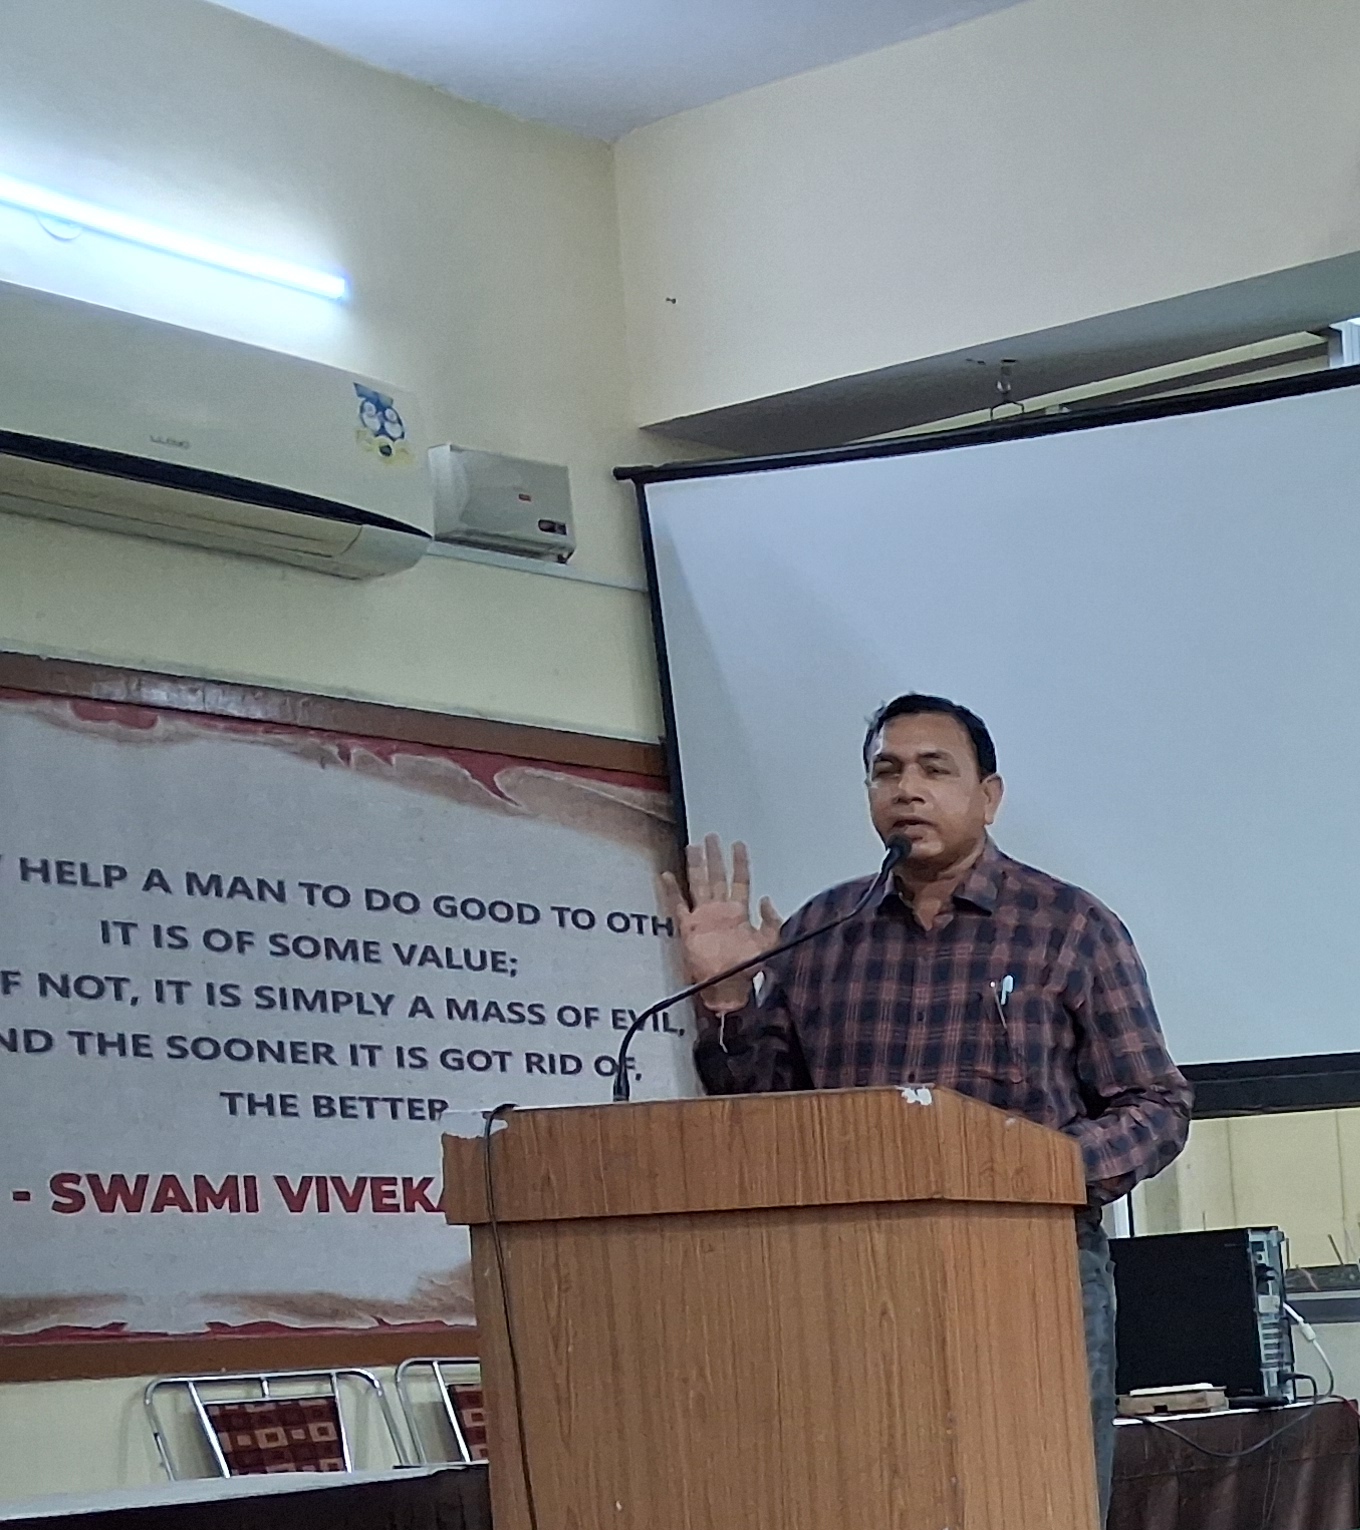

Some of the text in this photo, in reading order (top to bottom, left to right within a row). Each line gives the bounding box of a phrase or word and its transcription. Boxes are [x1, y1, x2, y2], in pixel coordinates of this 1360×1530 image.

[19, 856, 676, 938] HELP A MAN TO DO GOOD TO OTH
[100, 919, 518, 977] IT IS OF SOME VALUE;
[38, 972, 139, 1007] NOT,
[154, 978, 192, 1005] IT
[205, 982, 241, 1008] IS
[254, 985, 394, 1020] SIMPLY
[408, 996, 434, 1020] A
[446, 998, 546, 1026] MASS
[556, 1005, 600, 1030] OF
[67, 1030, 153, 1059] THE
[166, 1034, 335, 1067] SOONER
[350, 1042, 382, 1069] IT
[396, 1044, 428, 1070] IS
[440, 1049, 513, 1074] GOT
[525, 1052, 582, 1077] RID
[219, 1091, 299, 1118] THE
[50, 1171, 260, 1214] SWAMI
[273, 1174, 446, 1214] VIVEK
